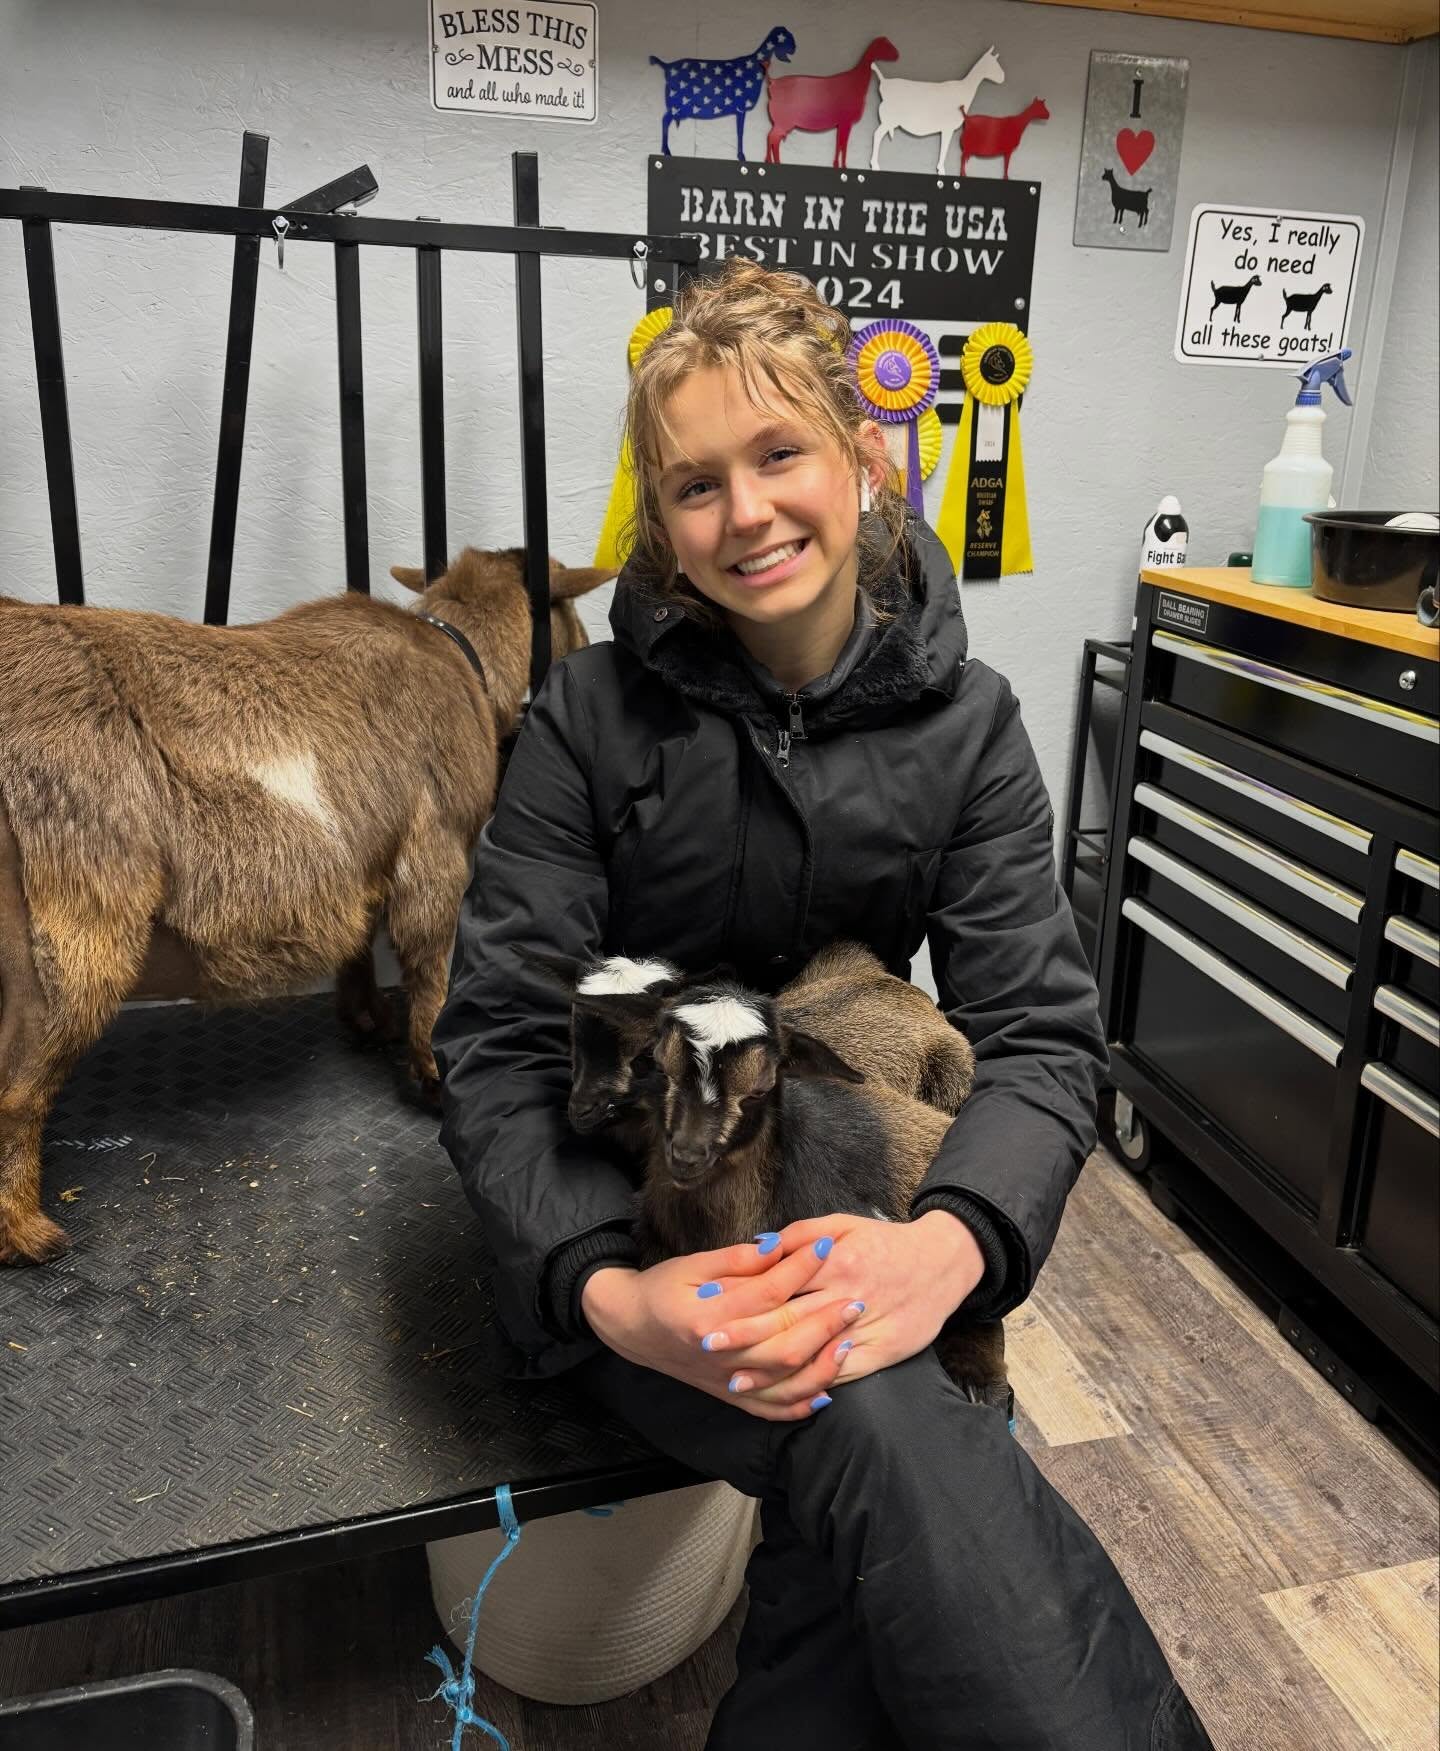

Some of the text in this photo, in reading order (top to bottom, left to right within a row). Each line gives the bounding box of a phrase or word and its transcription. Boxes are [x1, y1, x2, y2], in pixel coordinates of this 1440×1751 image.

[439, 9, 588, 50] BLESS THIS
[476, 43, 554, 76] MESS
[447, 79, 585, 109] and all who made it!
[1129, 79, 1145, 119] I
[680, 187, 1008, 242] BARN IN THE USA
[1220, 218, 1341, 254] Yes, I really
[698, 232, 1005, 276] BEST IN SHOW
[1234, 248, 1316, 275] do need
[814, 275, 904, 310] 024
[1191, 325, 1333, 356] all these goats!
[971, 477, 1004, 489] ADGA
[1147, 550, 1175, 565] Fight
[1162, 598, 1205, 619] BALL BEARING
